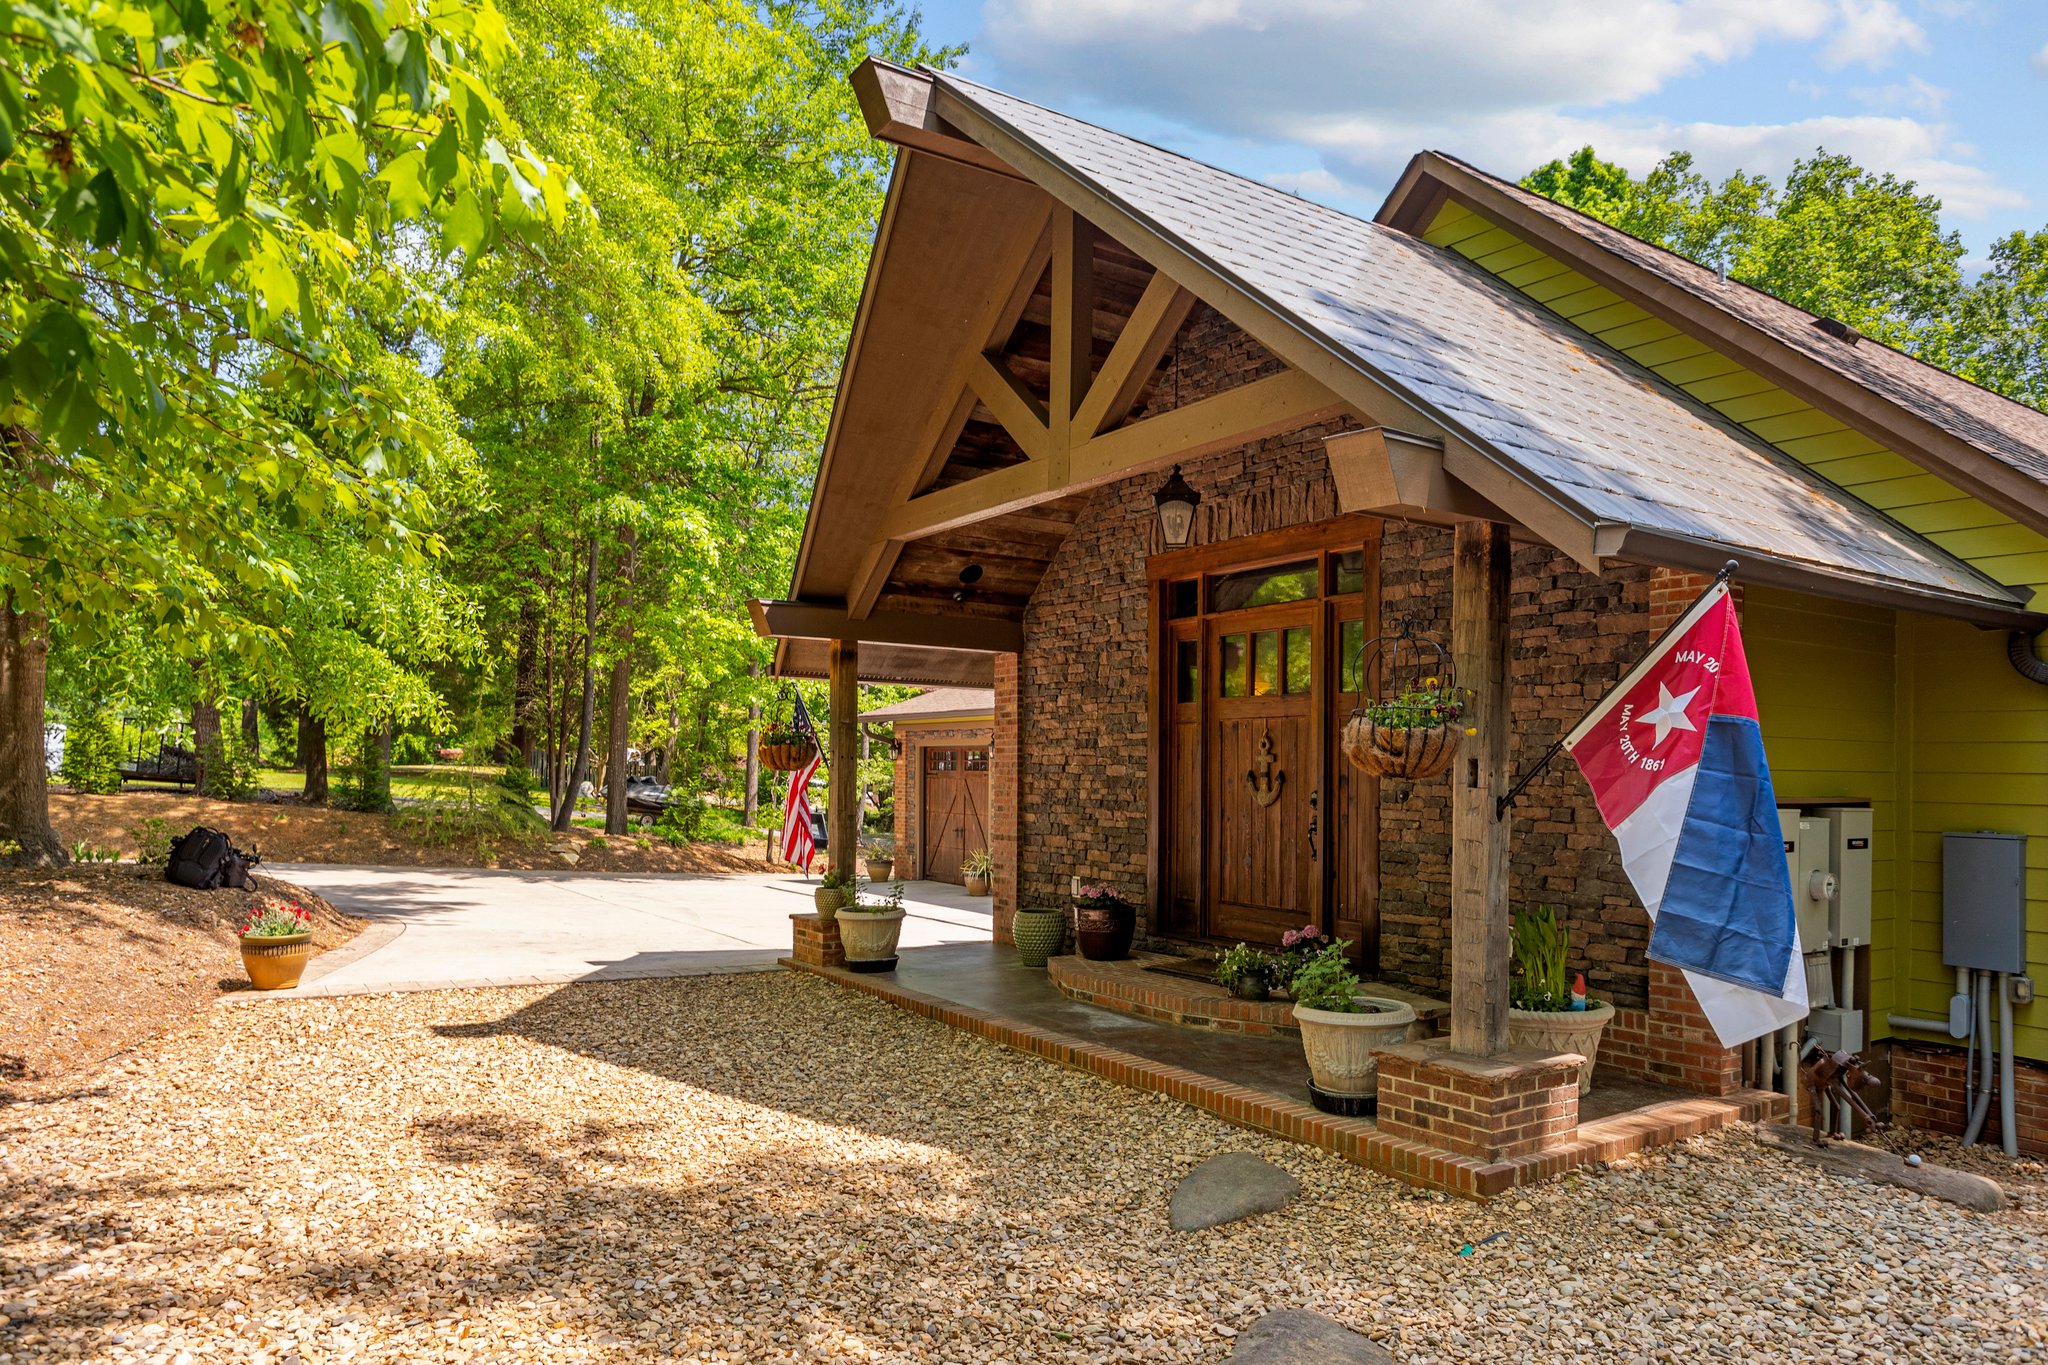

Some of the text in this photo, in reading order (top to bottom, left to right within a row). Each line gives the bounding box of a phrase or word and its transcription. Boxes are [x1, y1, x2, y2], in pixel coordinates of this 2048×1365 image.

[1674, 650, 1720, 678] MAY 20
[1619, 704, 1665, 772] MAY 20TH 1861
